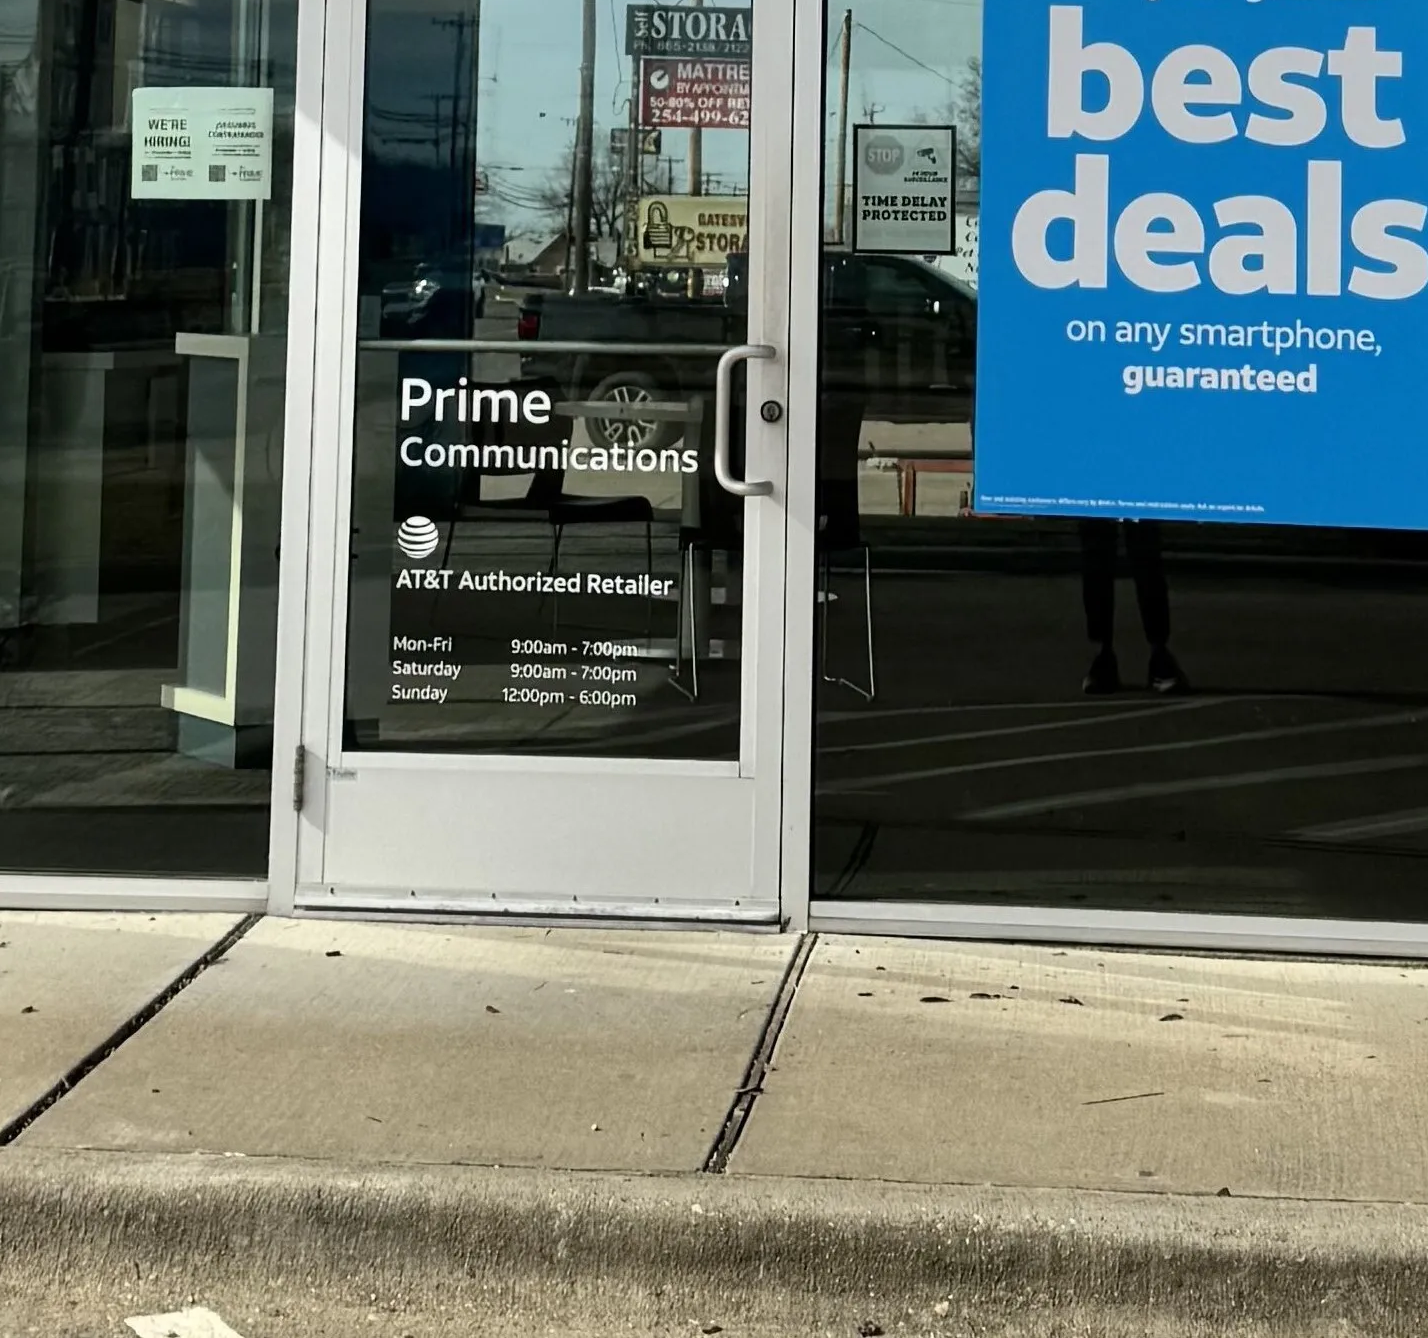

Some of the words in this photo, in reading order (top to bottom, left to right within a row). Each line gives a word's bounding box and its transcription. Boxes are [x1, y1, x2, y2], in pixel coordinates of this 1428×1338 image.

[651, 10, 751, 41] STORA
[677, 62, 750, 80] MATTRE
[1047, 5, 1407, 148] best
[676, 82, 690, 94] BY
[698, 97, 722, 109] OFF
[148, 119, 188, 131] WE'RE
[144, 136, 191, 148] HIRING!
[867, 148, 901, 163] STOP
[861, 195, 898, 206] TIME
[901, 196, 948, 207] DELAY
[861, 210, 947, 221] PROTECTED
[1066, 320, 1106, 342] on
[1115, 320, 1171, 352] any
[1179, 318, 1383, 357] smartphone,
[1122, 363, 1318, 395] guaranteed
[400, 376, 552, 425] Prime
[400, 436, 699, 474] Communications
[395, 568, 453, 590] AT&T
[458, 570, 581, 593] Authorized
[587, 574, 674, 596] Retailer
[393, 636, 453, 652] Mon-Fri
[511, 639, 568, 655] 9:00am
[582, 641, 638, 660] 7:00pm
[392, 660, 462, 681] Saturday
[510, 663, 567, 679] 9:00am
[581, 665, 637, 685] 7:00pm
[391, 684, 448, 704] Sunday
[501, 687, 565, 707] 12:00pm
[579, 689, 637, 709] 6:00pm
